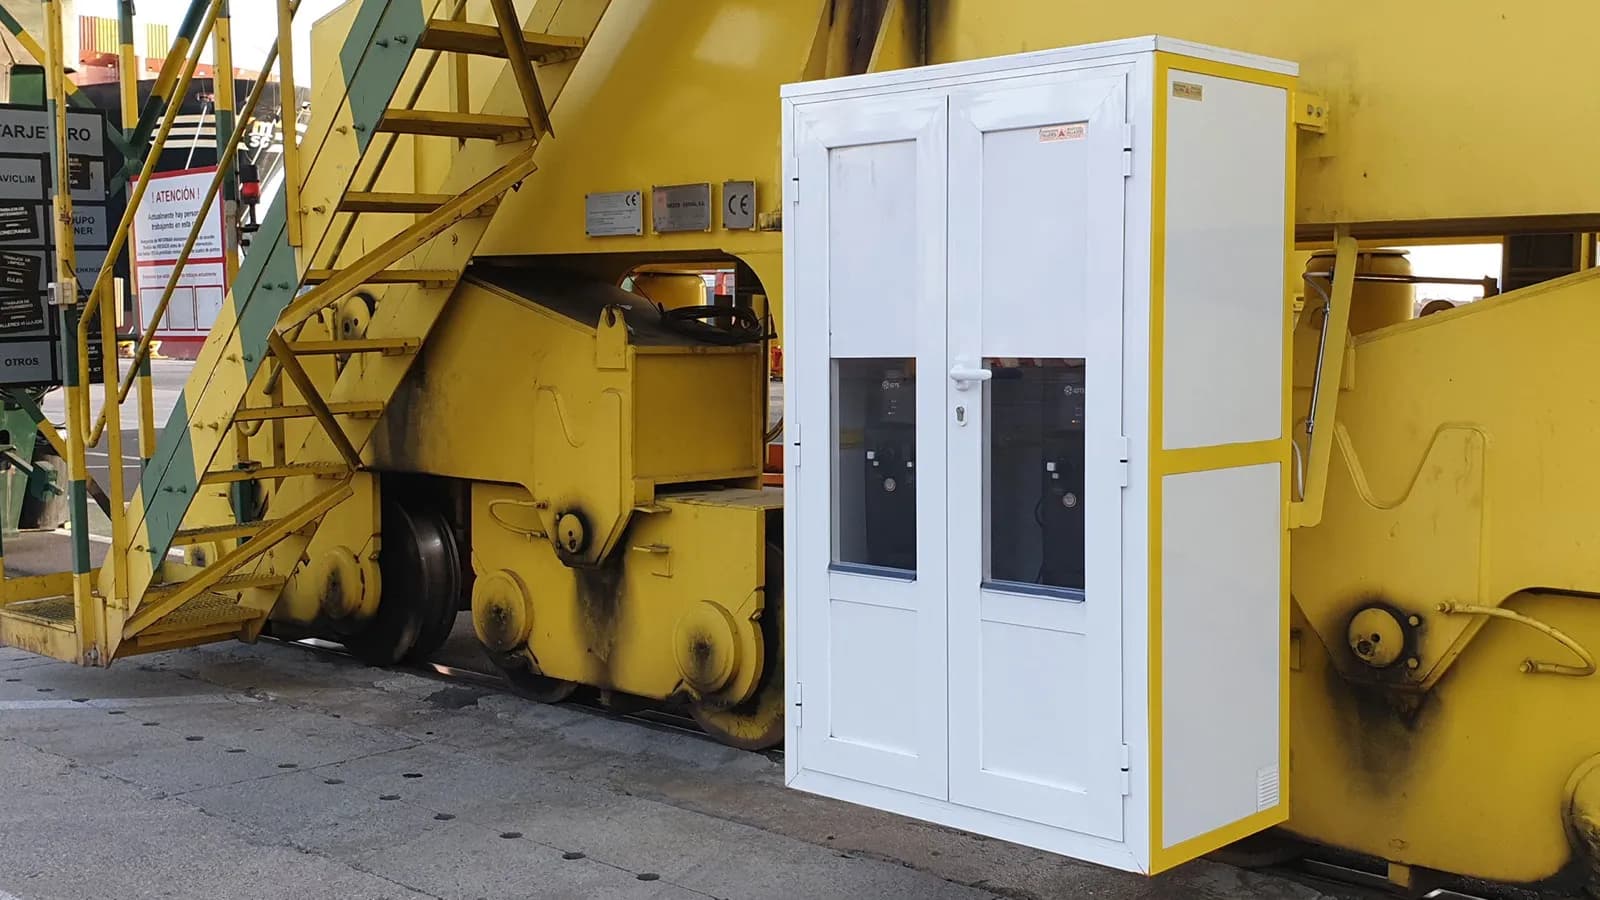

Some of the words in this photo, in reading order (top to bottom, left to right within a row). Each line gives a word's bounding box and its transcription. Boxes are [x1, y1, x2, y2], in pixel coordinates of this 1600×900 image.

[0, 124, 91, 141] ARJERO
[156, 186, 195, 203] ATENCIÓN
[728, 194, 749, 216] CE
[175, 211, 183, 219] hay
[151, 223, 174, 231] trabajando
[4, 357, 39, 367] OTROS
